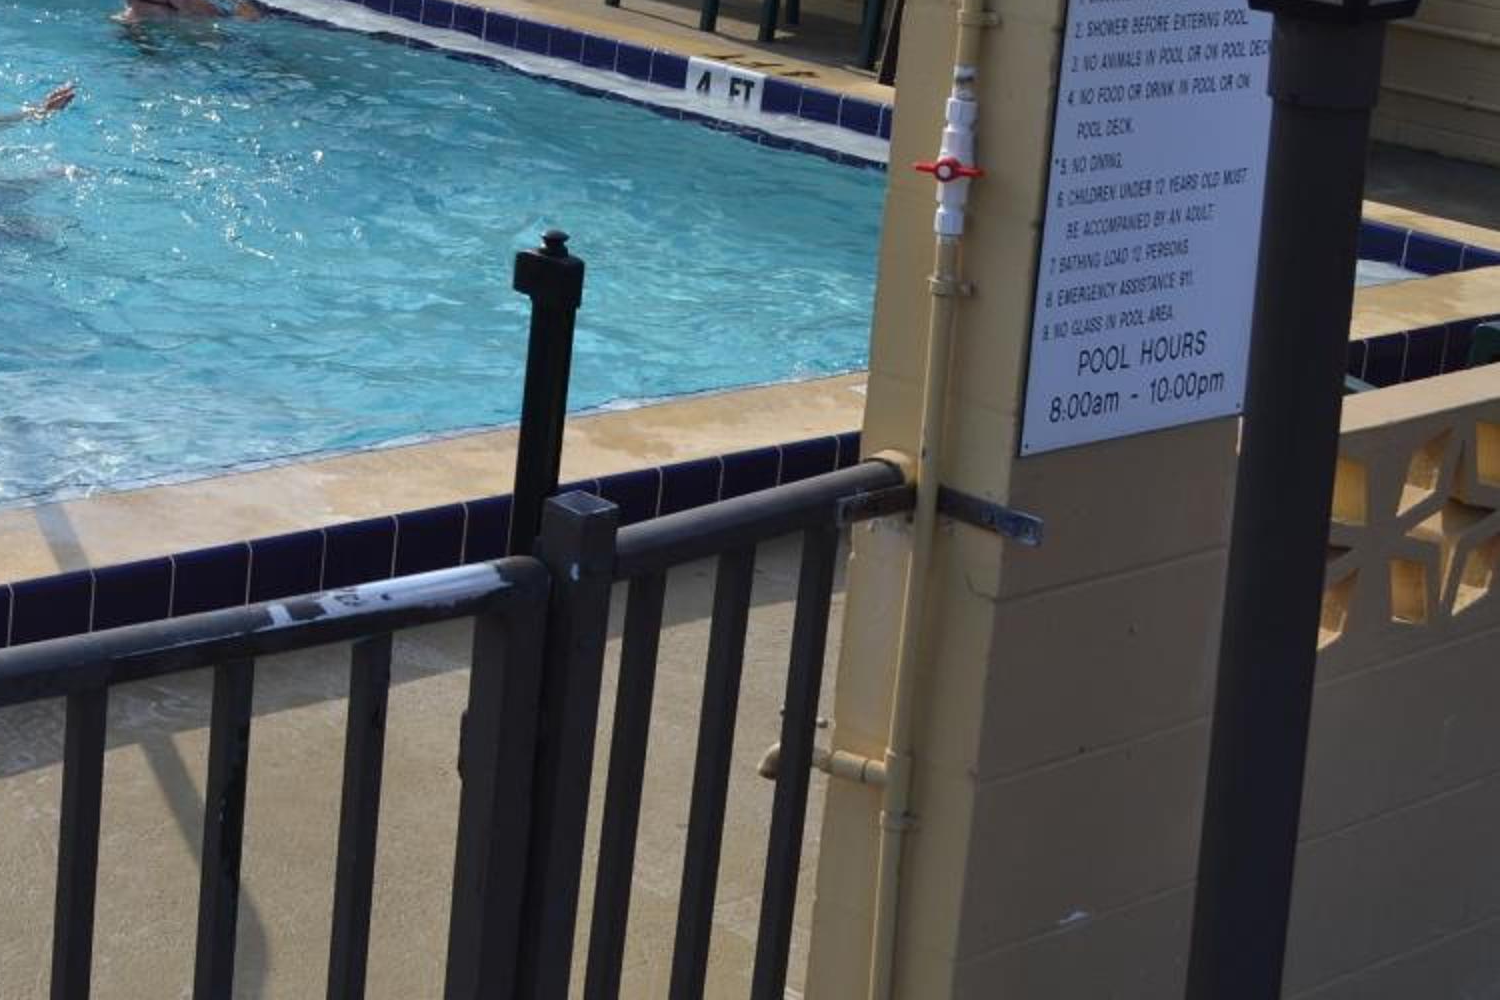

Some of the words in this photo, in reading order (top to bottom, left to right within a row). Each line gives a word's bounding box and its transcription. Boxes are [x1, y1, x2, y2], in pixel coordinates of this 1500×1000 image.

[1087, 17, 1129, 38] SHOWER
[1132, 14, 1170, 35] BEFORE
[1173, 11, 1220, 31] ENTERING
[1099, 50, 1141, 72] ANIMALS
[1159, 45, 1184, 65] POOL
[1222, 40, 1247, 60] POOL
[1249, 38, 1269, 57] DEC
[729, 76, 755, 103] FT
[1097, 84, 1125, 105] FOOD
[1145, 79, 1174, 100] DRINK
[1192, 76, 1216, 95] POOL
[1076, 120, 1102, 140] POOL
[1067, 184, 1114, 207] CHILDREN
[1118, 178, 1152, 200] UNDER
[1169, 173, 1199, 195] YEARS
[1223, 167, 1249, 185] MUST
[1083, 211, 1150, 236] ACCOMPANIED
[1059, 251, 1101, 274] BATHING
[1104, 247, 1129, 267] LOAD
[1058, 282, 1117, 307] EMERGENCY
[1120, 271, 1175, 295] ASSISTANCE
[1071, 315, 1103, 336] GLASS
[1119, 308, 1144, 328] POOL
[1077, 344, 1131, 377] POOL
[1140, 330, 1207, 366] HOURS
[1049, 391, 1120, 423] 8:00am
[1150, 371, 1225, 405] 10:00pm
